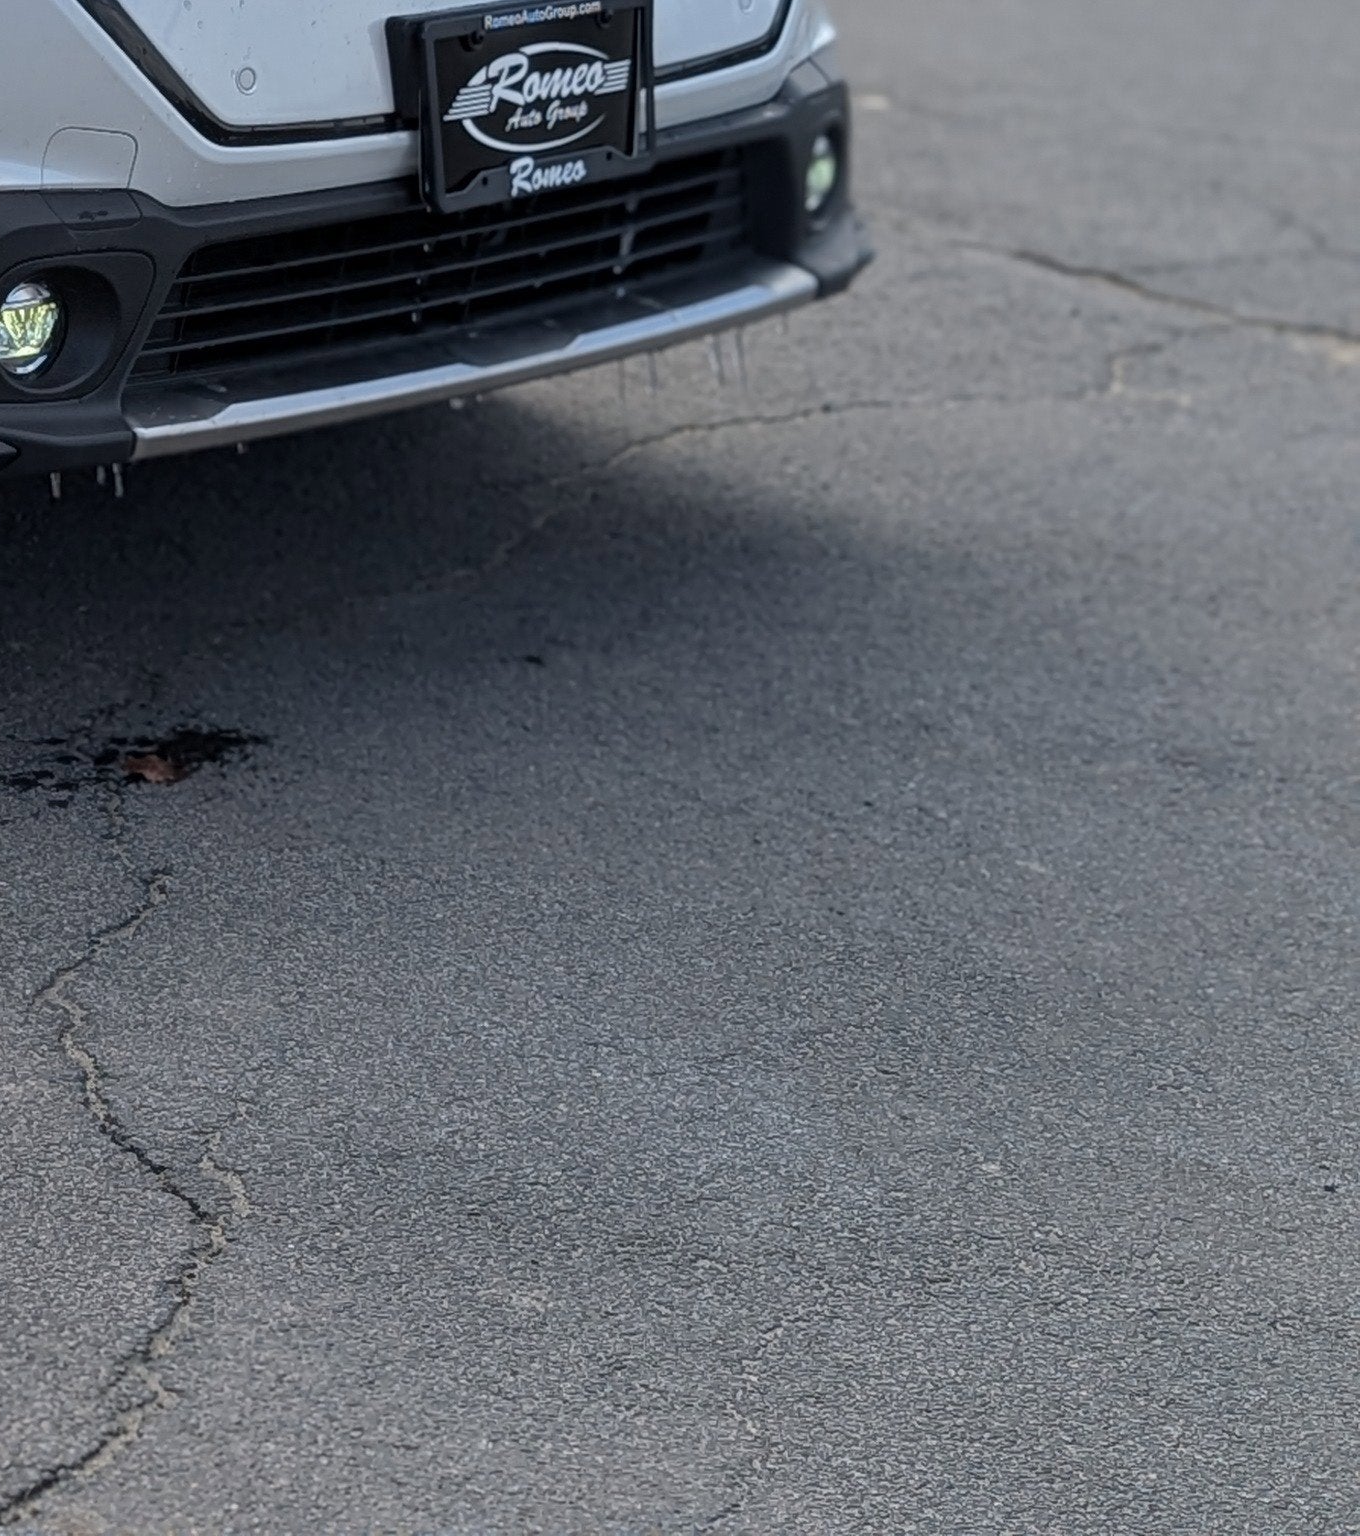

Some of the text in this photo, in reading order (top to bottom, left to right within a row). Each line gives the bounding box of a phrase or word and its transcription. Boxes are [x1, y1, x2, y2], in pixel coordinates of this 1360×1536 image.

[484, 1, 602, 30] RomeoAutoGroup.com
[487, 52, 606, 113] Romeo
[505, 100, 589, 132] Auto Group
[509, 157, 587, 197] Romeo
